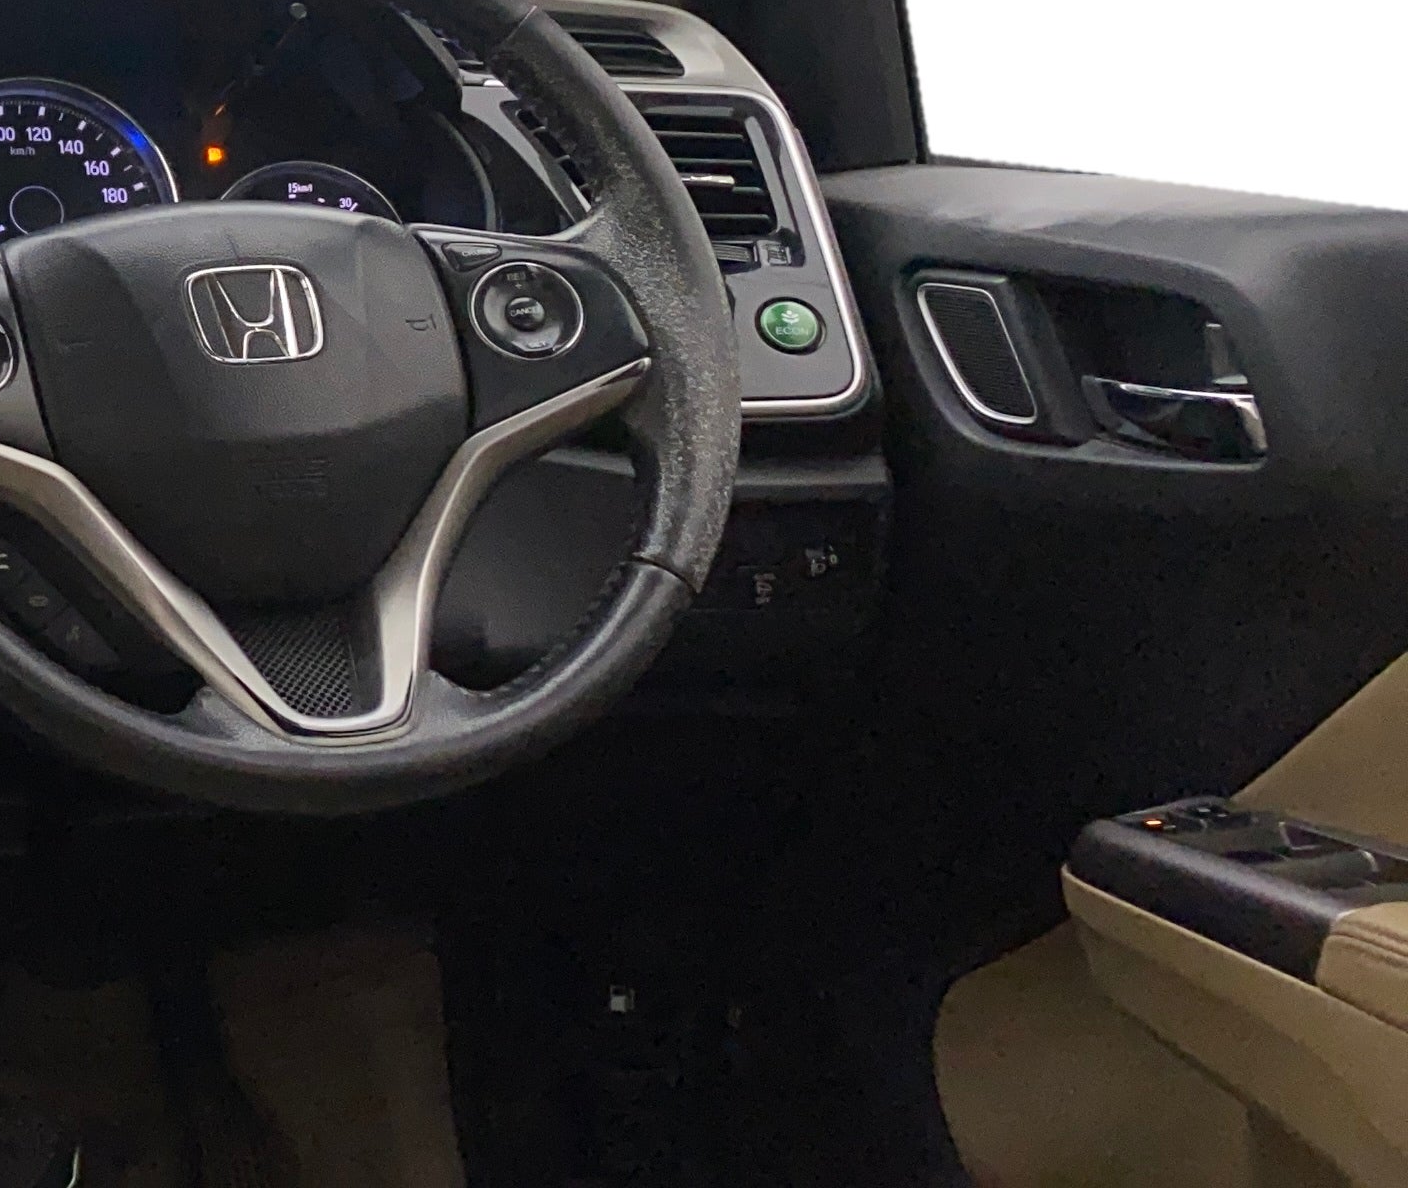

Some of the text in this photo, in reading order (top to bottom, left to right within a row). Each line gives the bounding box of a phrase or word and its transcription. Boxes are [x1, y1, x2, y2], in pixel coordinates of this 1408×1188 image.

[26, 126, 52, 142] 120
[9, 145, 36, 156] km/h
[58, 139, 84, 155] 140
[84, 160, 110, 177] 160
[101, 187, 128, 204] 180
[339, 196, 353, 209] 30
[775, 325, 810, 336] ECON
